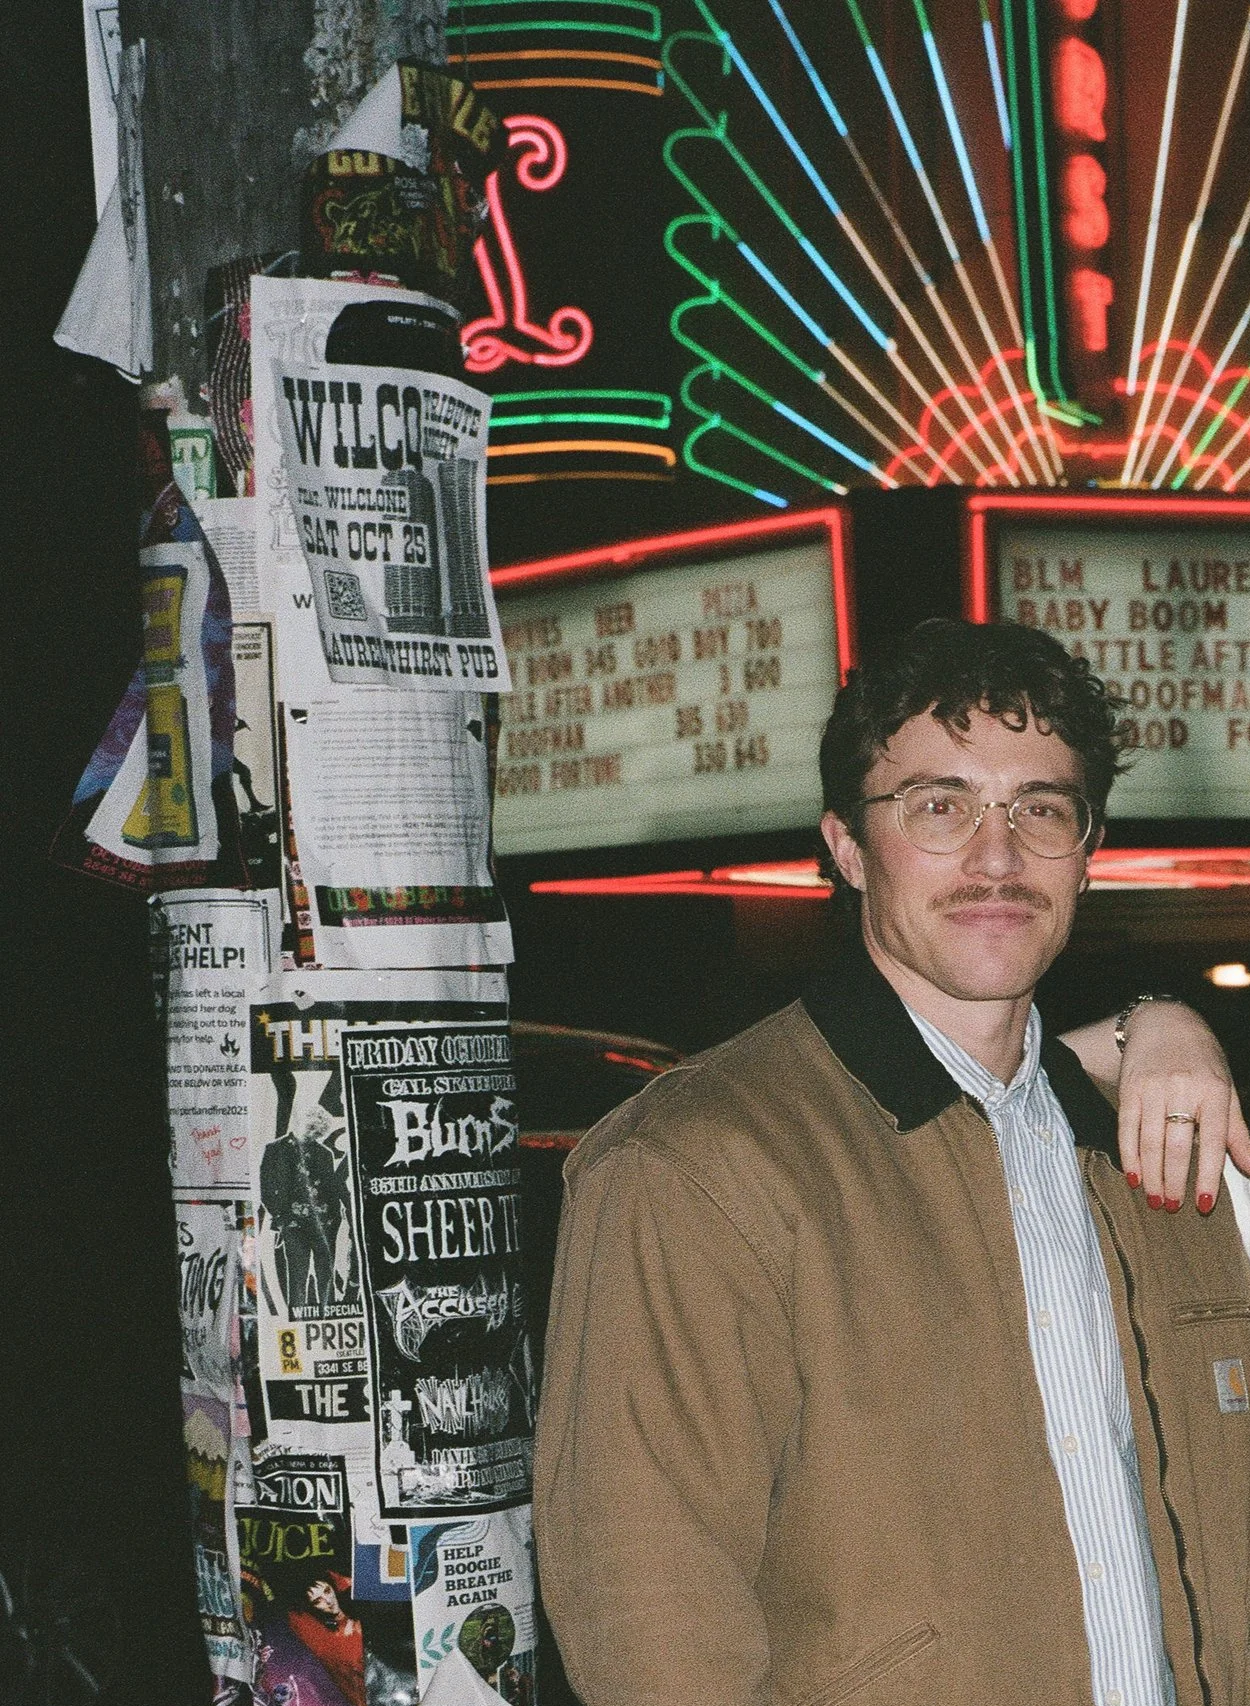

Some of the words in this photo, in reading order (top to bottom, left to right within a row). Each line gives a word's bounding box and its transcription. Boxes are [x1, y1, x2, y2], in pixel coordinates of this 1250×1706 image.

[282, 376, 424, 470] WILCO
[423, 388, 483, 437] TRIBUTE
[324, 486, 407, 512] WILCLONE
[303, 515, 339, 557] SAT
[347, 521, 393, 561] OCT
[403, 524, 428, 564] 25
[1013, 558, 1084, 594] BLM
[1128, 602, 1228, 635] BOOM
[456, 644, 498, 678] PUB
[185, 946, 246, 970] HELP!
[347, 1035, 439, 1069] FRIDAY
[371, 1175, 418, 1195] 35TH
[382, 1197, 496, 1264] SHEER
[292, 1306, 321, 1320] WITH
[280, 1331, 297, 1359] 8
[294, 1382, 350, 1419] THE
[444, 1544, 484, 1561] HELP
[445, 1556, 502, 1577] BOOGIE
[445, 1569, 514, 1593] BREATHE
[447, 1587, 499, 1608] AGAIN
